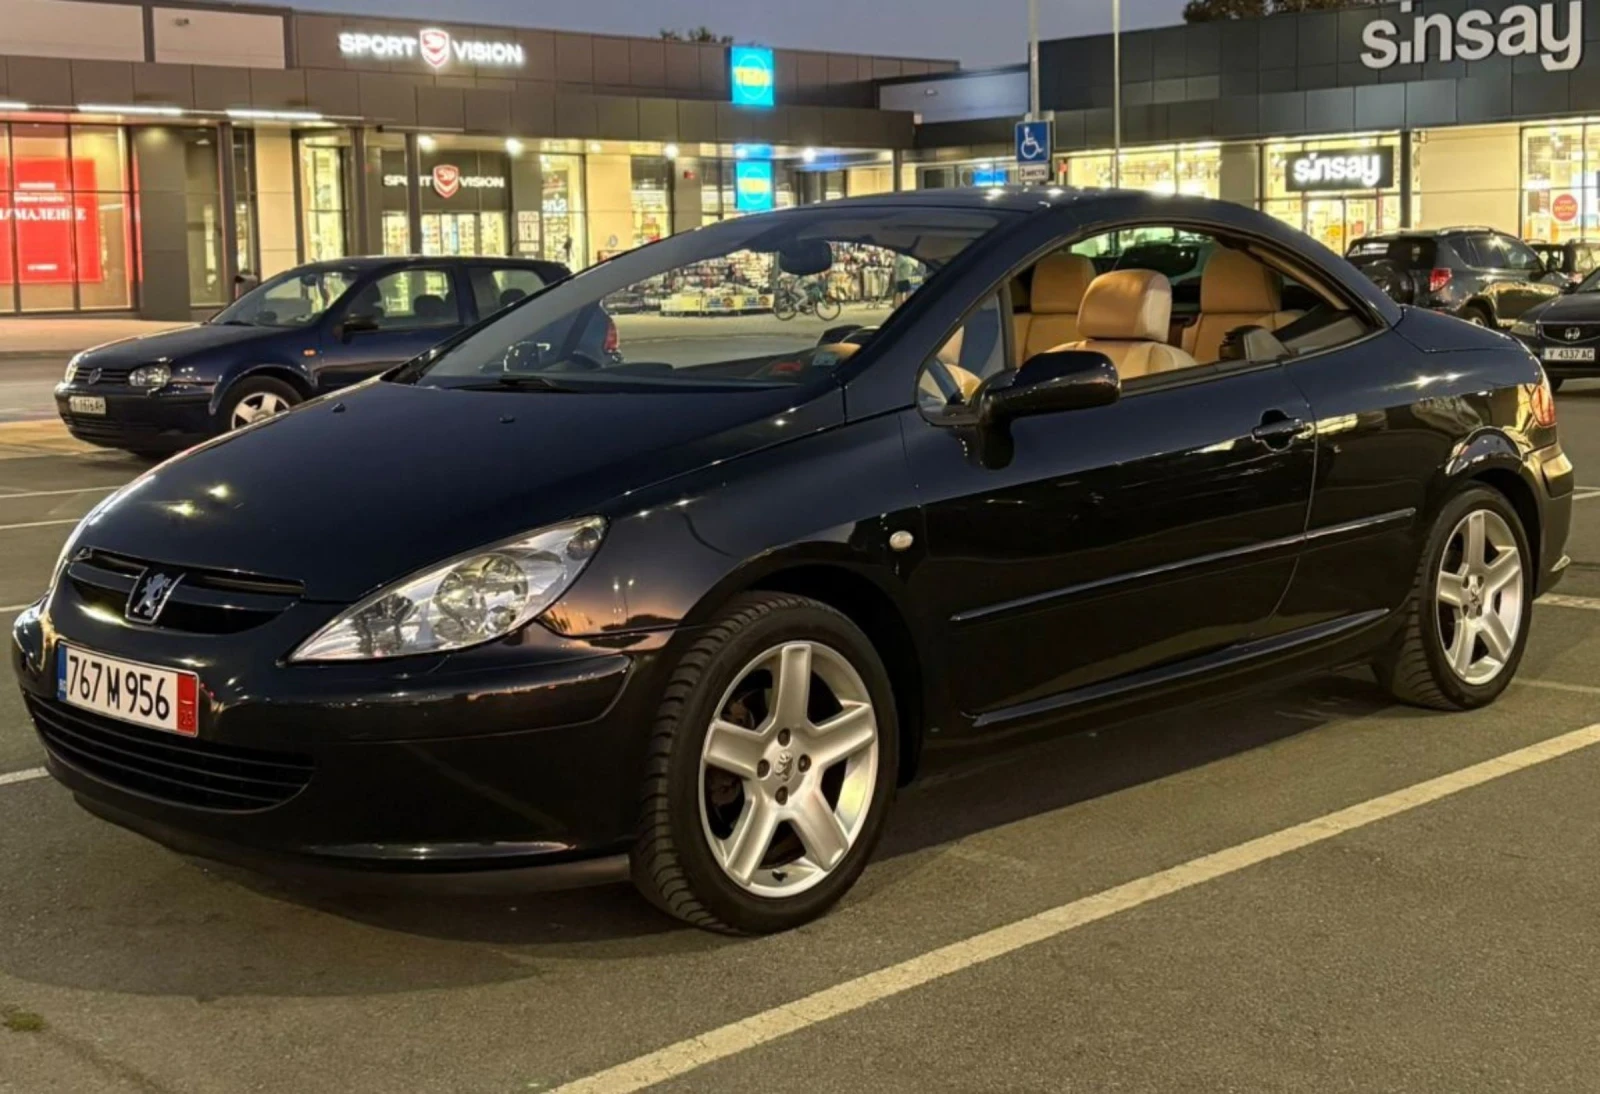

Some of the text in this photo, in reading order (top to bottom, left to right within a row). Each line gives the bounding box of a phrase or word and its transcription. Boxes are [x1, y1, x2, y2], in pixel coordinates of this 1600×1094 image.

[339, 33, 524, 63] SPORT VISION
[1360, 0, 1582, 71] sinsay
[383, 174, 505, 188] SPT VISION
[1293, 152, 1380, 187] sinsay
[69, 655, 170, 721] 767 M 956
